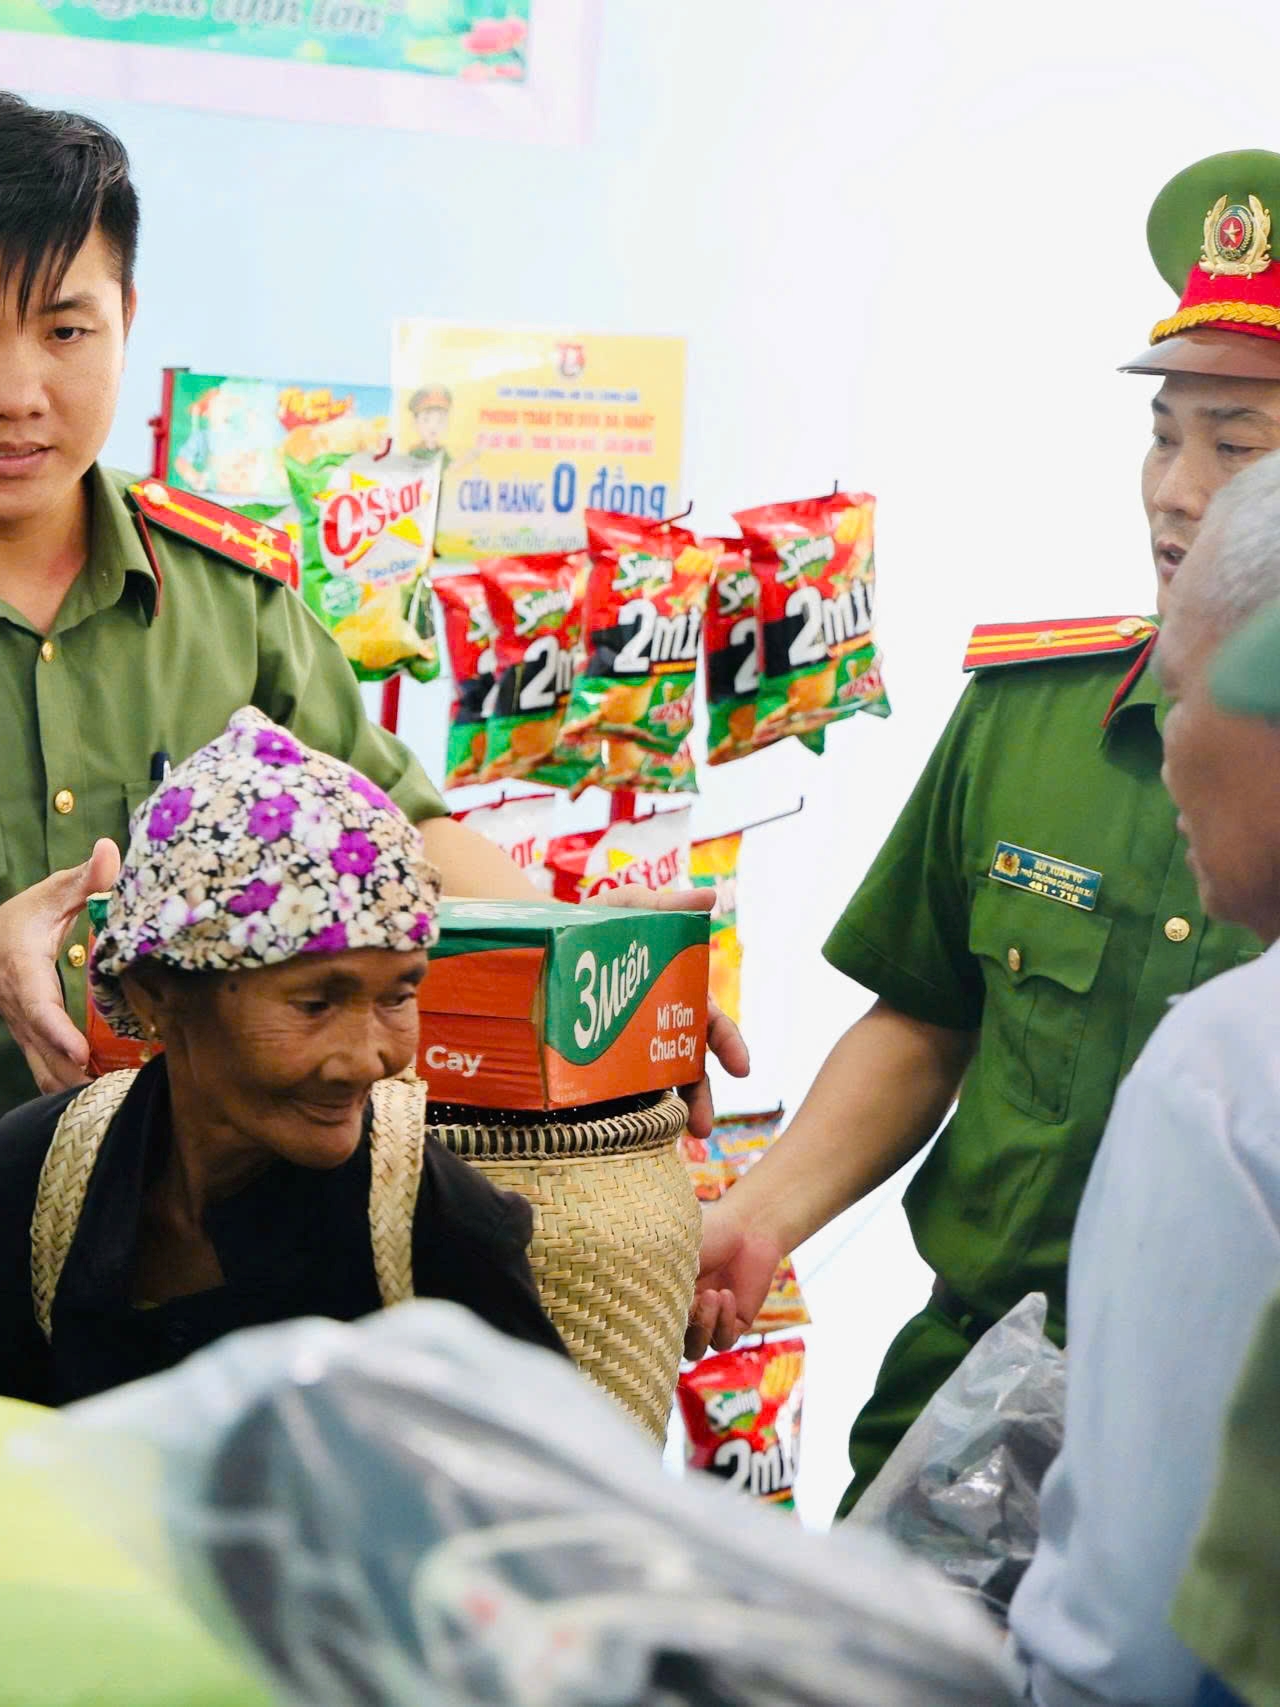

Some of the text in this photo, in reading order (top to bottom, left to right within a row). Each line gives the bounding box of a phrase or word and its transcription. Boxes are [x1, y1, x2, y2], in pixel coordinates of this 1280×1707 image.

[657, 1001, 694, 1031] Mì Tôm
[425, 1045, 484, 1078] Cay
[650, 1032, 697, 1063] Chua Cay
